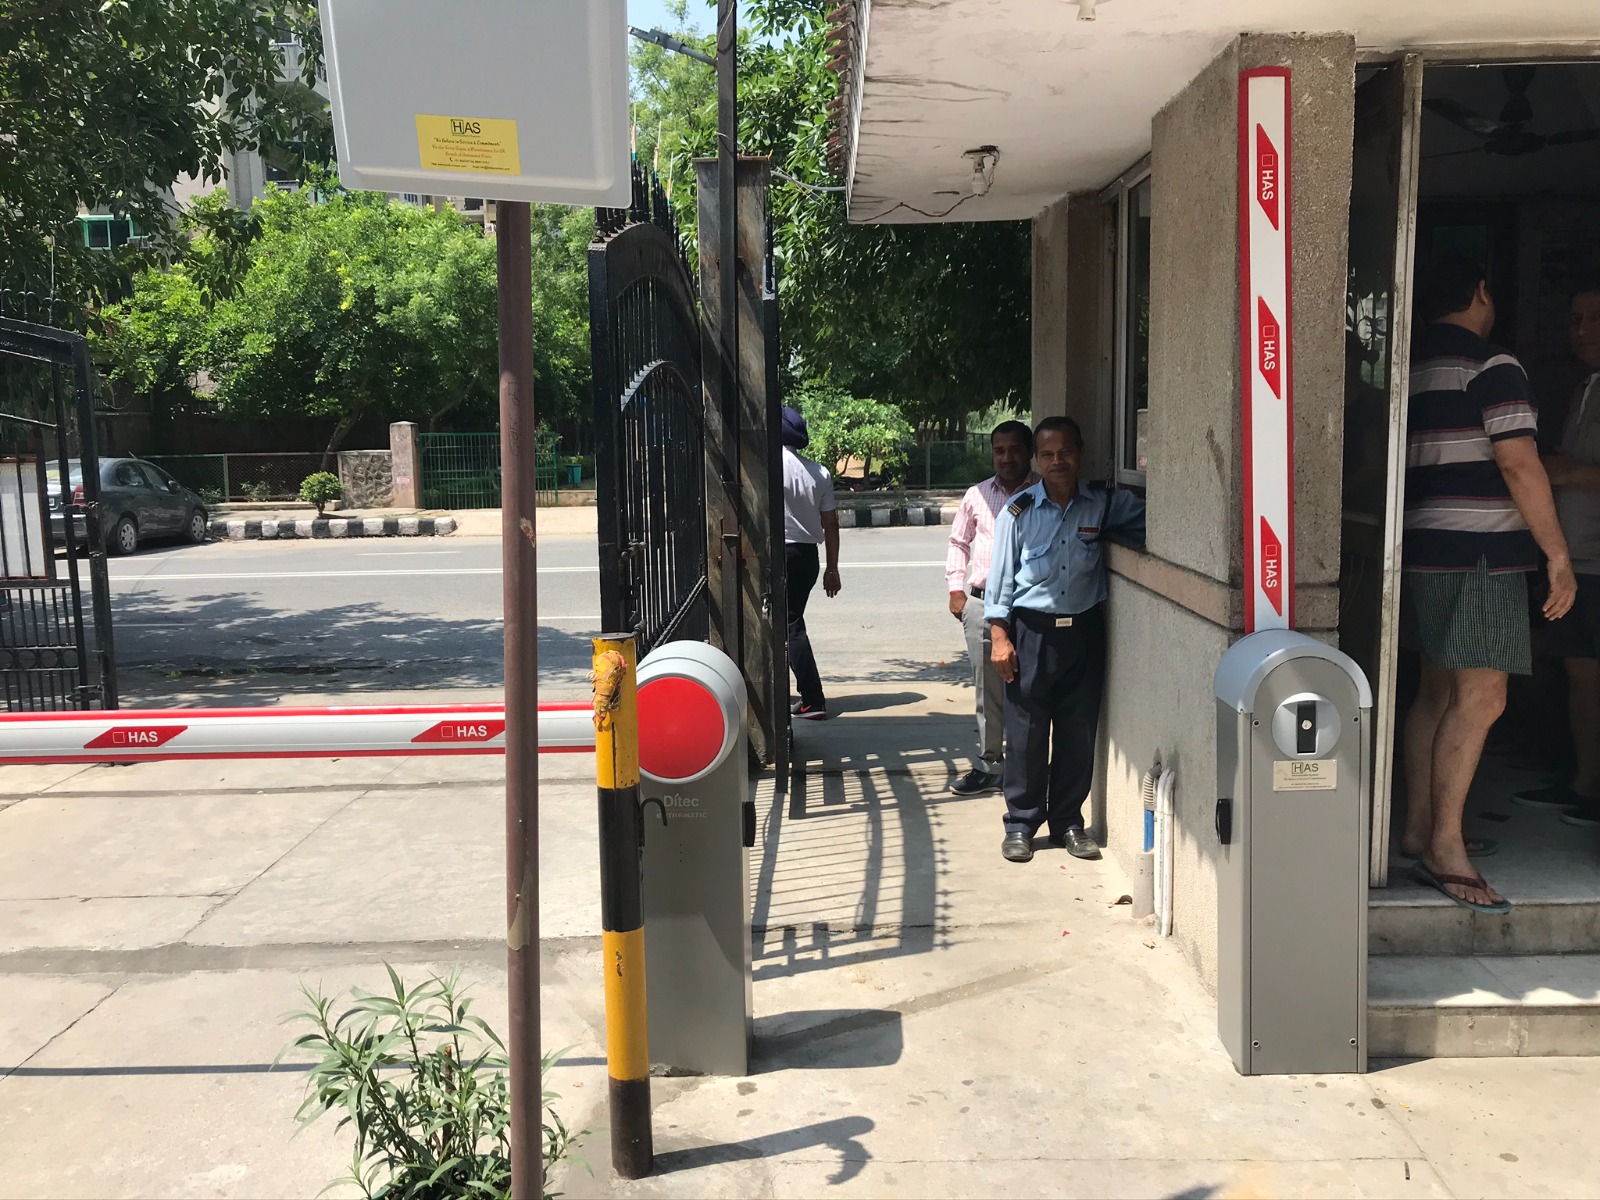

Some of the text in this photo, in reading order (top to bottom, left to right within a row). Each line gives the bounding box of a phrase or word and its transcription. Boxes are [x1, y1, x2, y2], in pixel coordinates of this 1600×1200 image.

[452, 119, 481, 134] HAS
[1262, 170, 1274, 200] HAS
[1264, 340, 1276, 370] HAS
[1265, 560, 1278, 588] HAS
[128, 731, 158, 744] HAS
[457, 725, 487, 738] HAS
[1292, 762, 1319, 774] HAS
